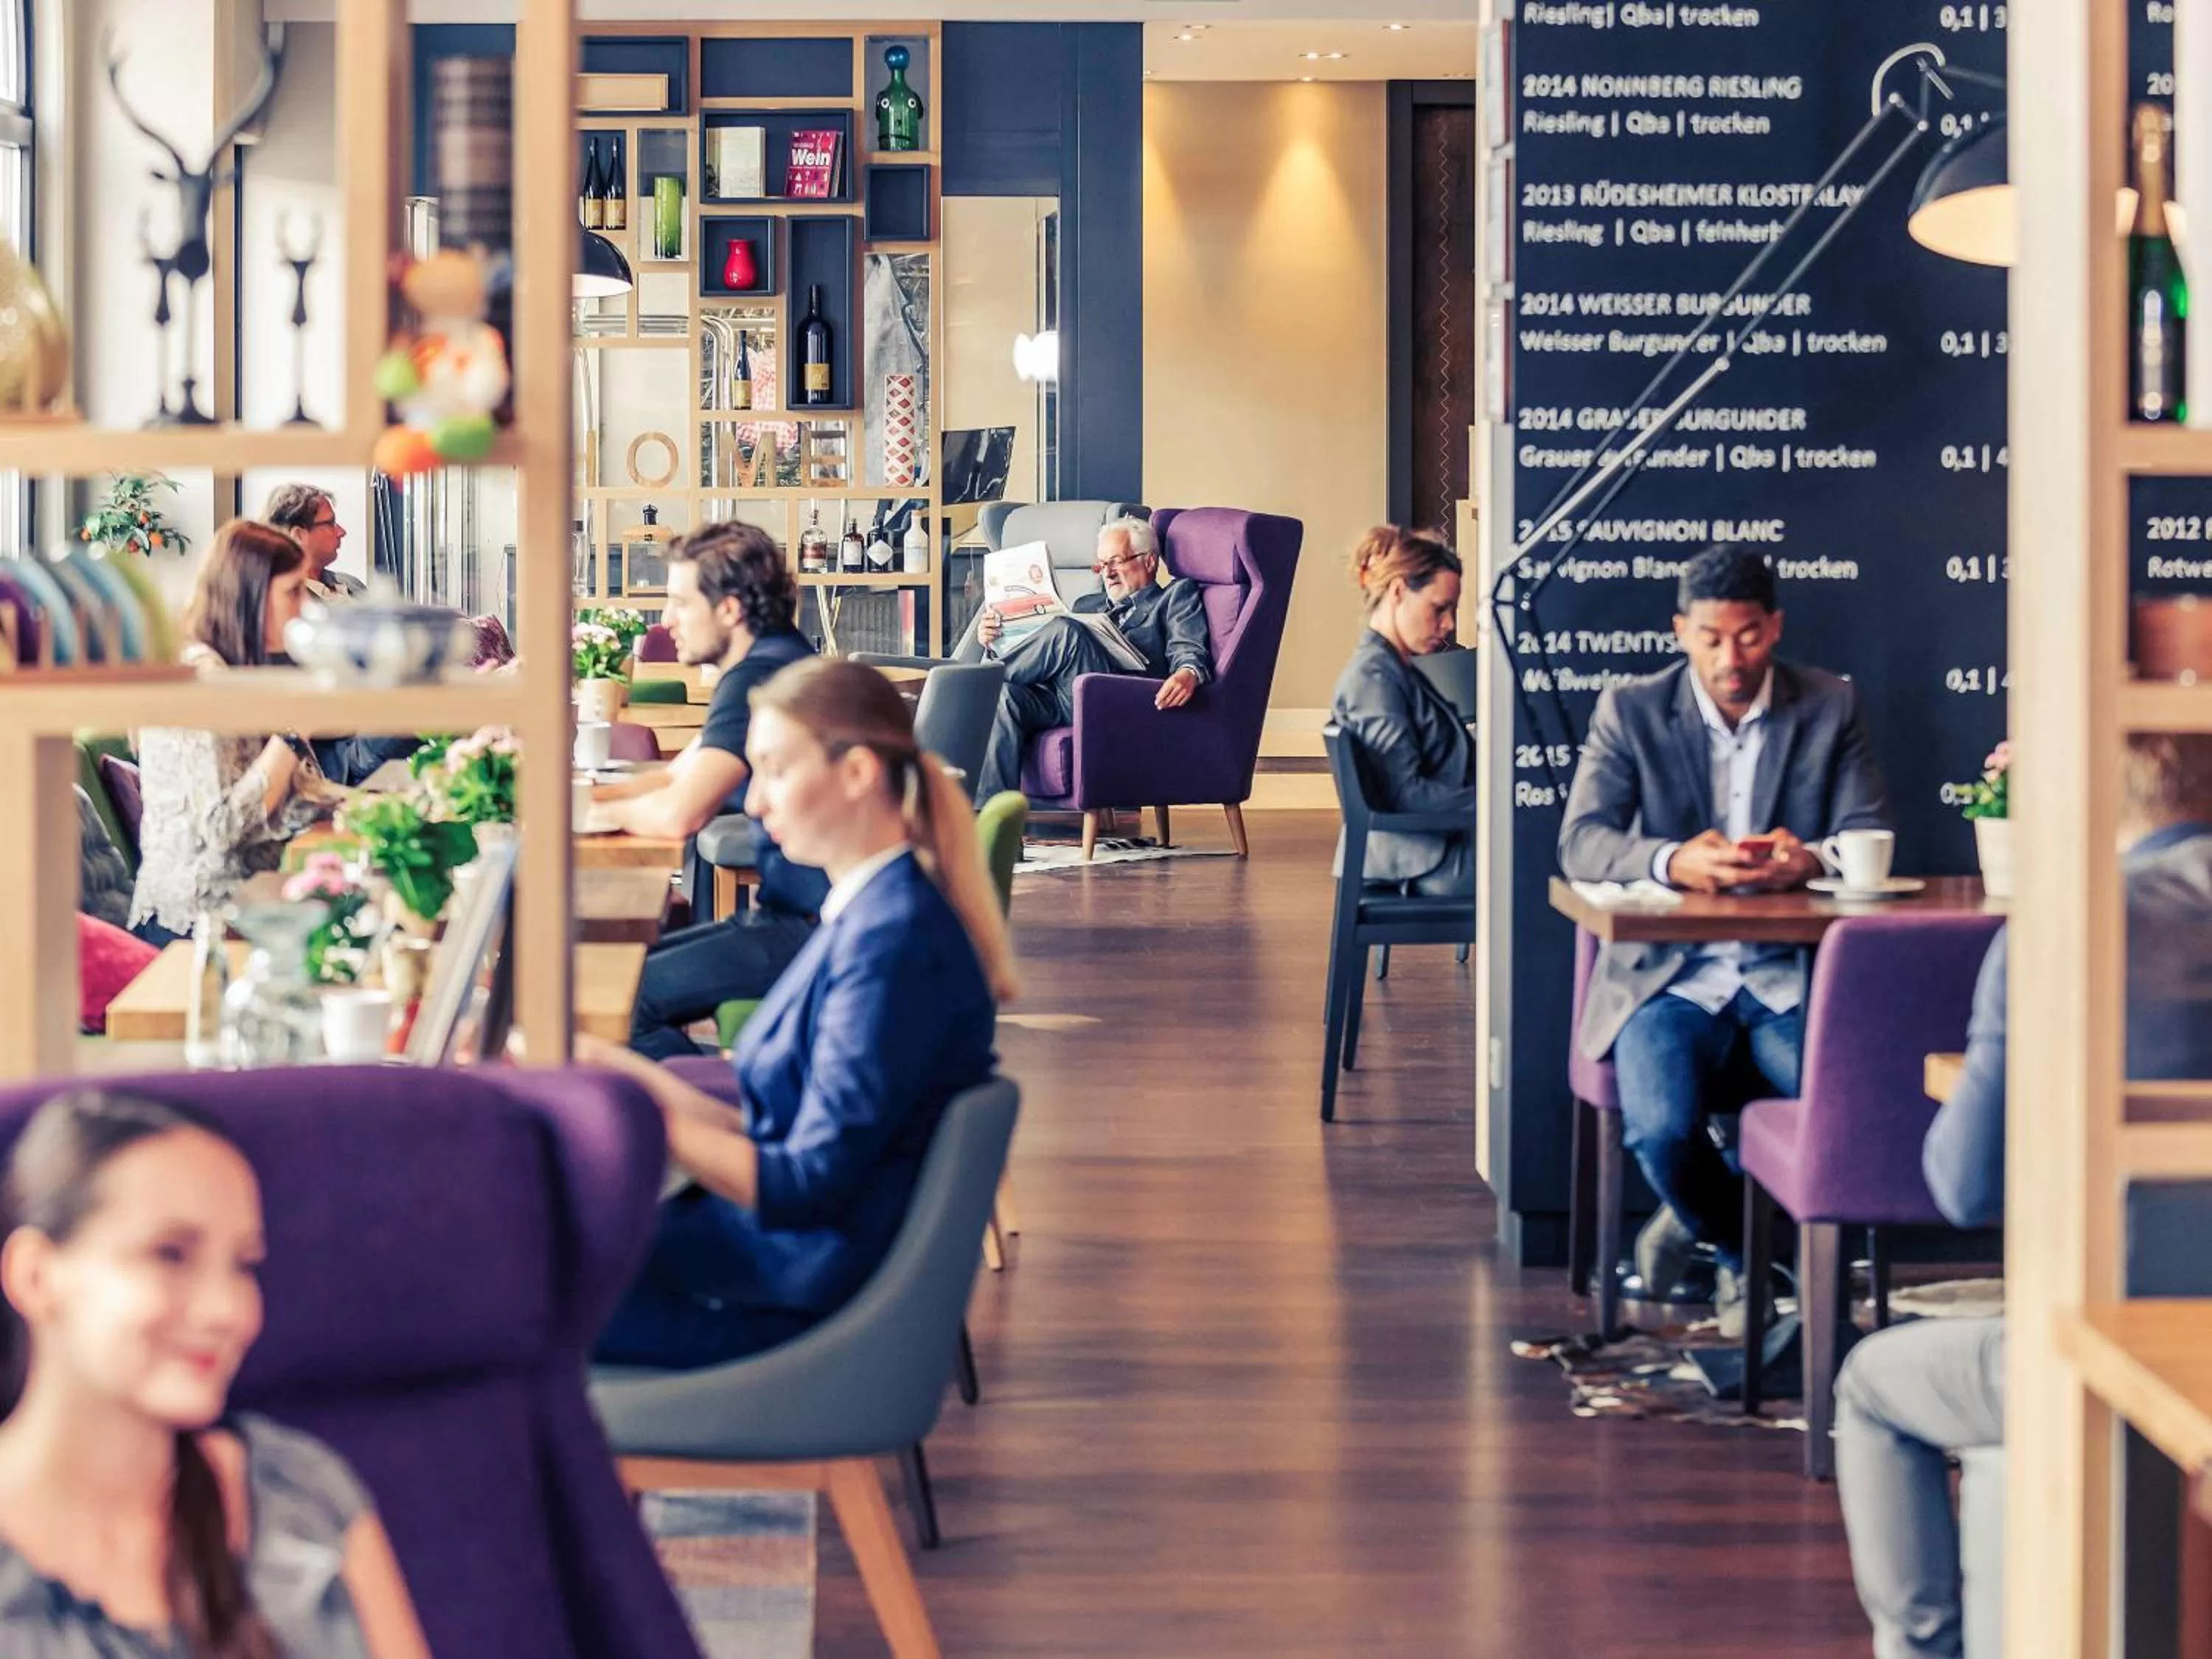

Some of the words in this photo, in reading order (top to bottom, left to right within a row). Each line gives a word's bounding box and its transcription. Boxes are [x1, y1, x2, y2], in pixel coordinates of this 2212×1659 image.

[1679, 4, 1760, 27] trocken
[1941, 5, 1974, 32] 0,1
[1523, 74, 1577, 97] 2014
[1581, 74, 1705, 98] NONNBERG
[1708, 74, 1803, 99] RIESLING
[1523, 110, 1606, 138] Riesling
[1626, 110, 1671, 136] Qba
[1690, 111, 1770, 134] trocken
[792, 149, 831, 166] Wein
[1522, 183, 1576, 206] 2013
[1580, 179, 1733, 207] RÜDESHEIMER
[1523, 219, 1604, 247] Riesling
[1630, 219, 1676, 245] Qba
[1520, 293, 1575, 316] 2014
[1578, 293, 1672, 316] WEISSER
[1520, 330, 1605, 352] Weisser
[1608, 330, 1721, 358] Burguner
[1806, 330, 1888, 353] trocken
[1941, 330, 1975, 358] 0,1
[1518, 407, 1573, 431] 2014
[1674, 408, 1806, 431] URGUNDER
[1519, 445, 1593, 467] Grauer
[1729, 443, 1776, 470] Qba
[1795, 444, 1877, 468] trocken
[1941, 445, 1976, 472] 0,1
[1518, 519, 1573, 542] 215
[1712, 519, 1785, 542] BLANC
[2146, 516, 2201, 540] 2012
[1777, 555, 1858, 580] trocken
[1947, 556, 1981, 583] 0,1
[2148, 556, 2212, 579] Rotwe
[1947, 669, 1981, 693] 0,1
